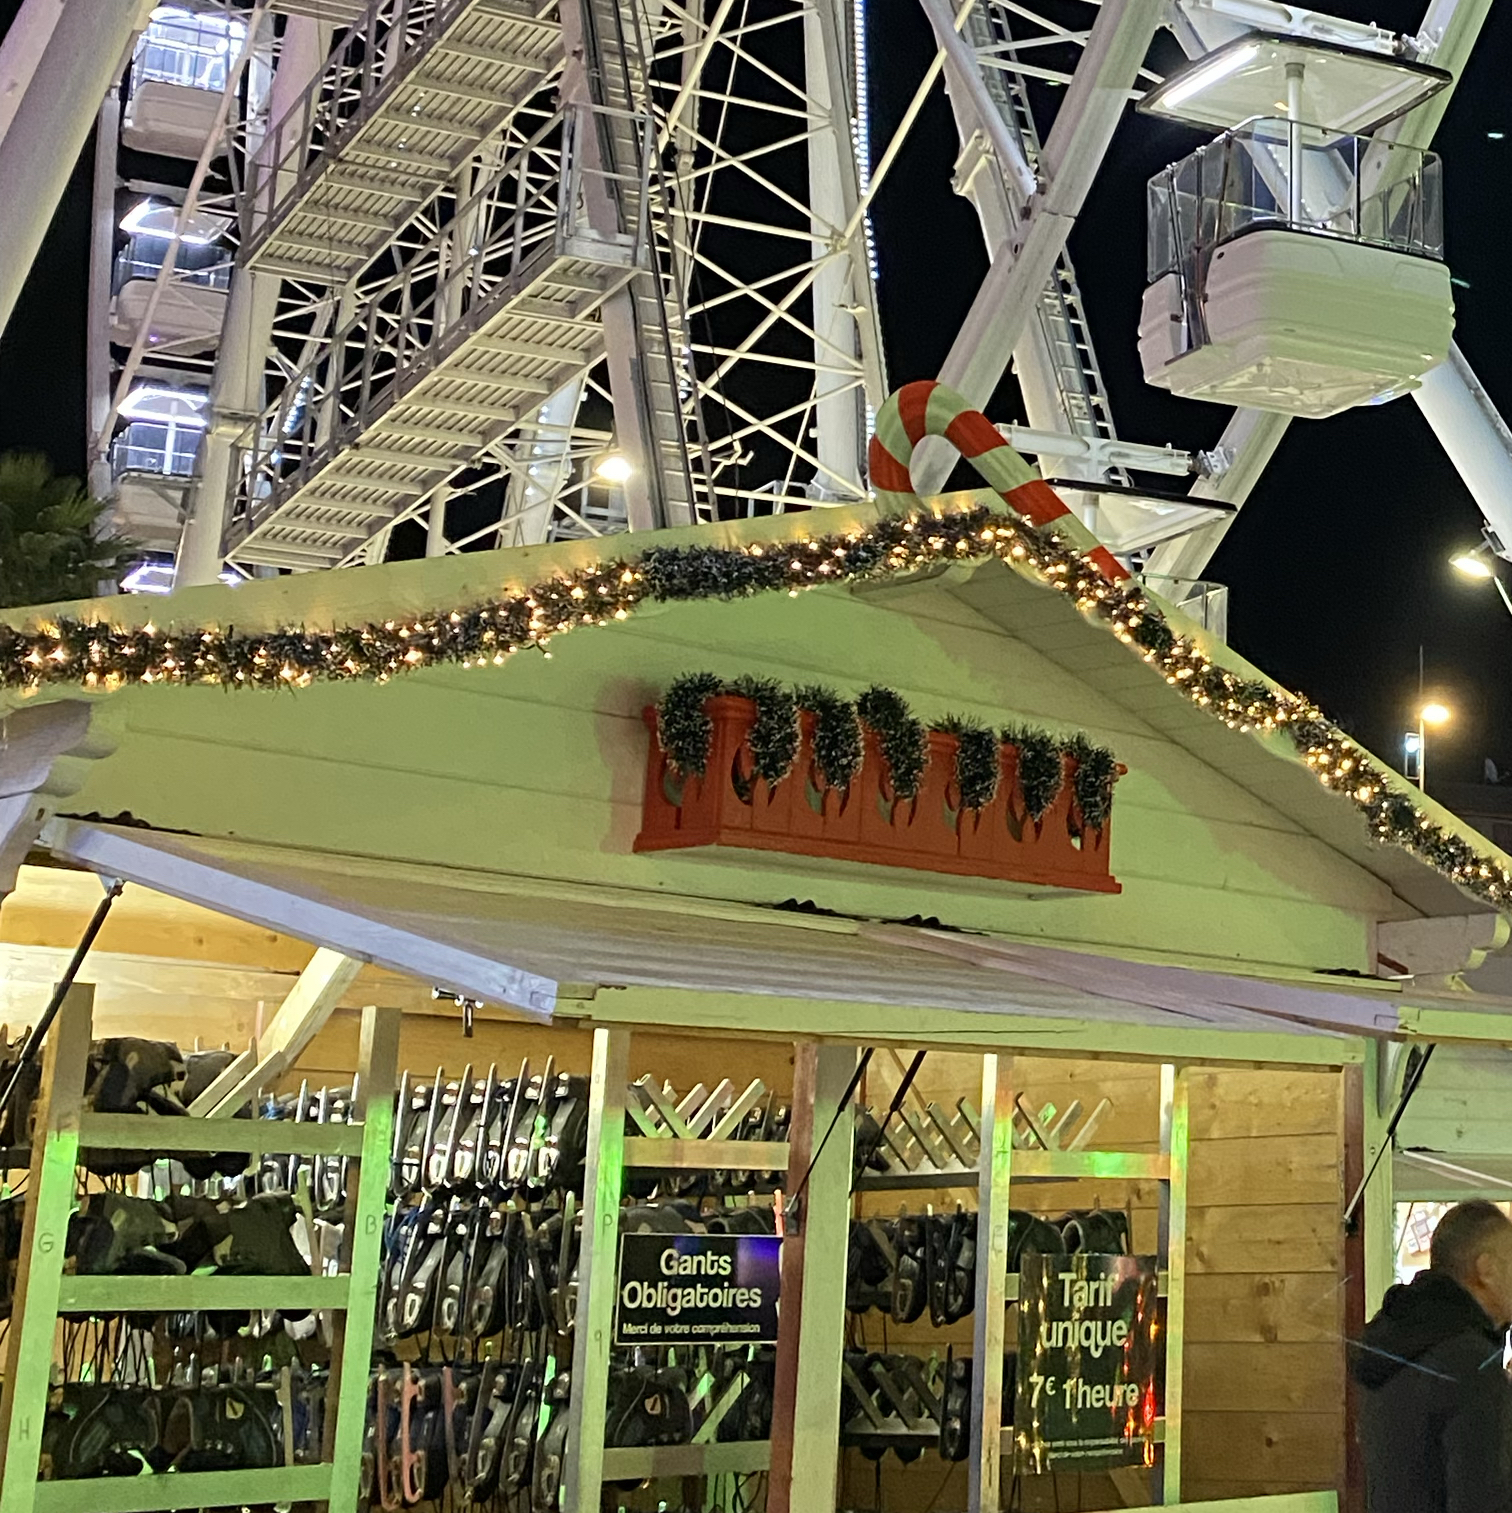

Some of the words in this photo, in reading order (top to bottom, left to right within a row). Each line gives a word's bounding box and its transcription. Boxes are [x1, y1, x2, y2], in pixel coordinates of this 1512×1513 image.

[660, 1248, 732, 1276] Gants
[622, 1280, 762, 1317] Obligatoires
[1058, 1272, 1115, 1308] Tarif
[622, 1322, 648, 1335] Merci
[649, 1322, 662, 1335] de
[664, 1324, 690, 1335] votre
[1041, 1317, 1129, 1358] unique
